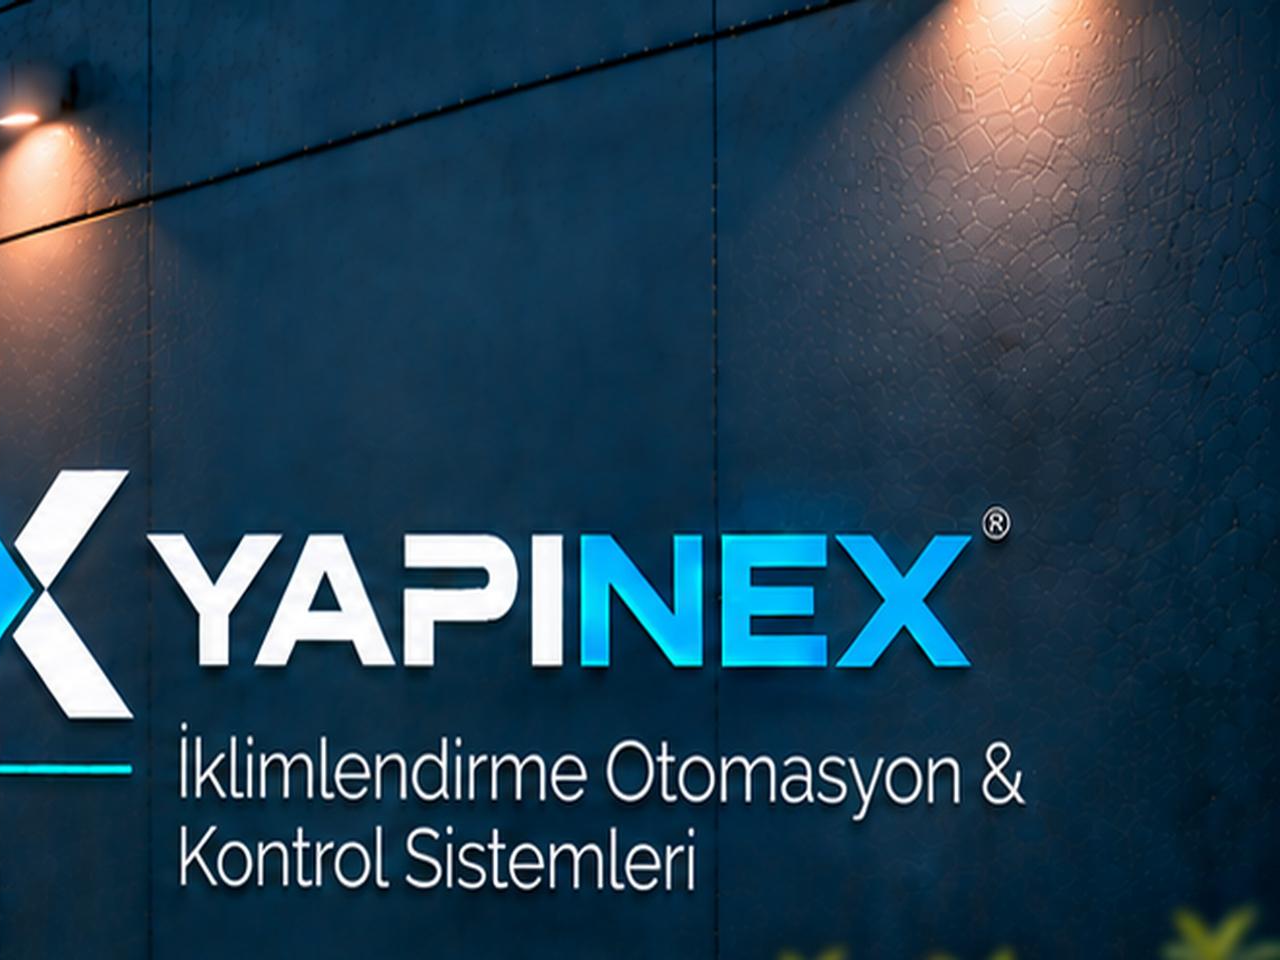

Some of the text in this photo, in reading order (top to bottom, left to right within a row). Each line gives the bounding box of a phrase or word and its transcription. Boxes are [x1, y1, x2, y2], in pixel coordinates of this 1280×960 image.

[181, 722, 1025, 821] İklimlendirme Otomasyon &
[180, 825, 695, 891] Kontrol Sistemleri
